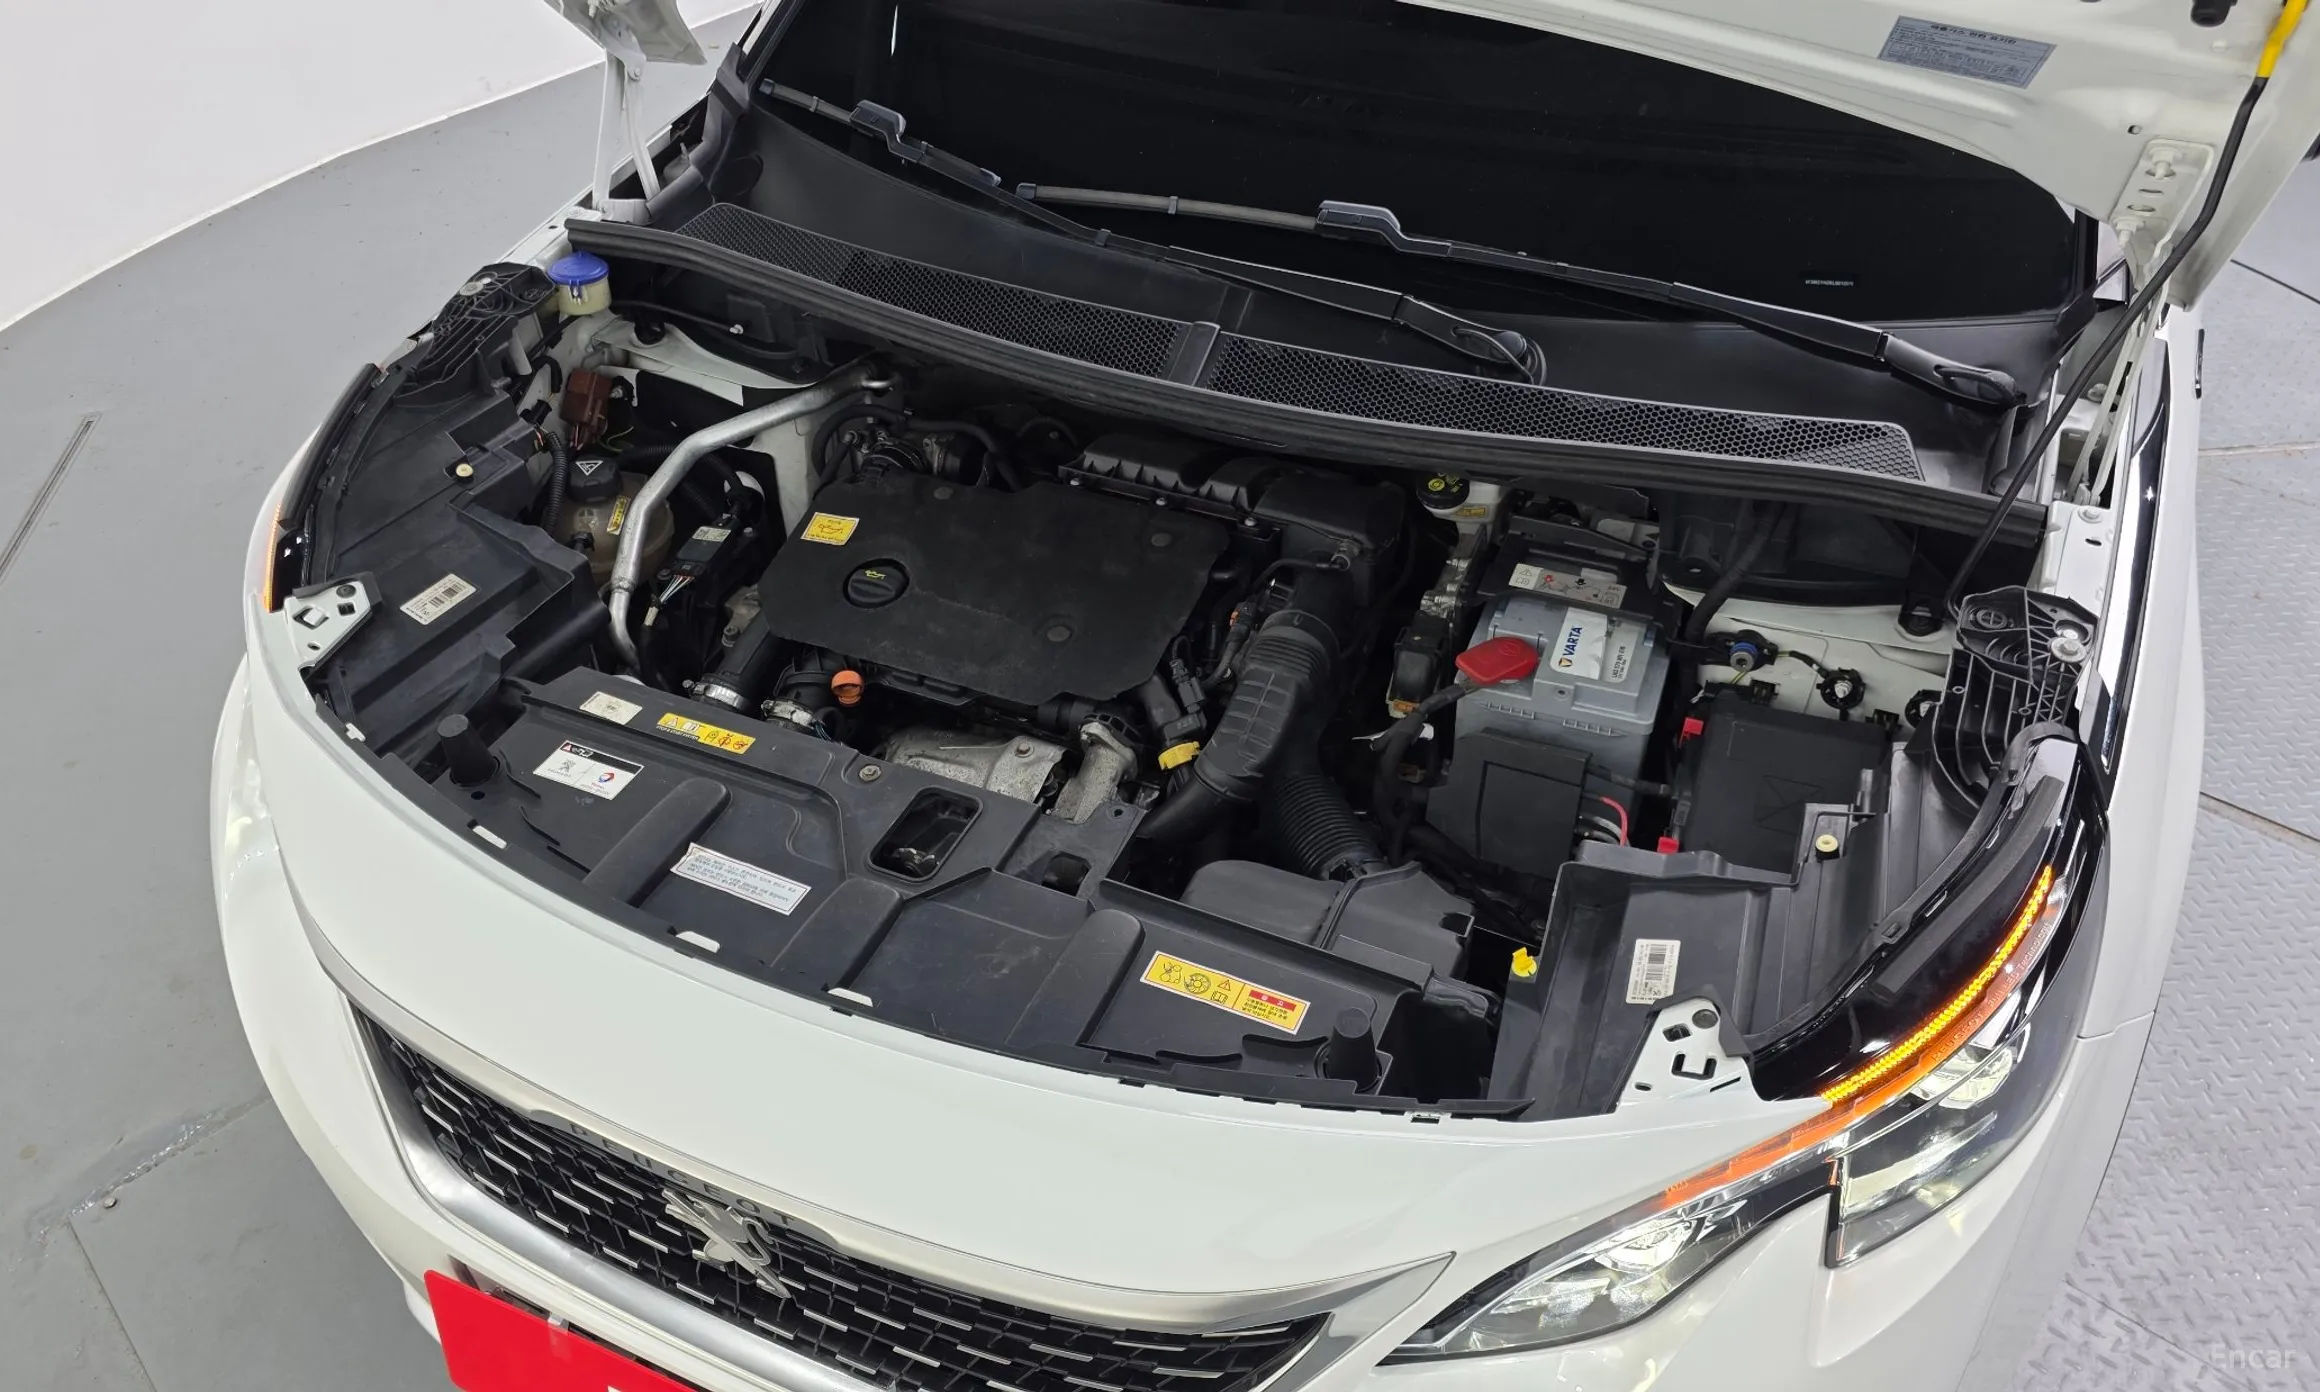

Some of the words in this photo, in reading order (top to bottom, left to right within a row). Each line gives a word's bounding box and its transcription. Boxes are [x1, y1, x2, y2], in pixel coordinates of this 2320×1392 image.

[1563, 626, 1583, 657] VARTA
[1931, 1010, 1985, 1063] PEUGEOT
[2016, 921, 2053, 970] Technology
[570, 1122, 796, 1227] PEUGEOT
